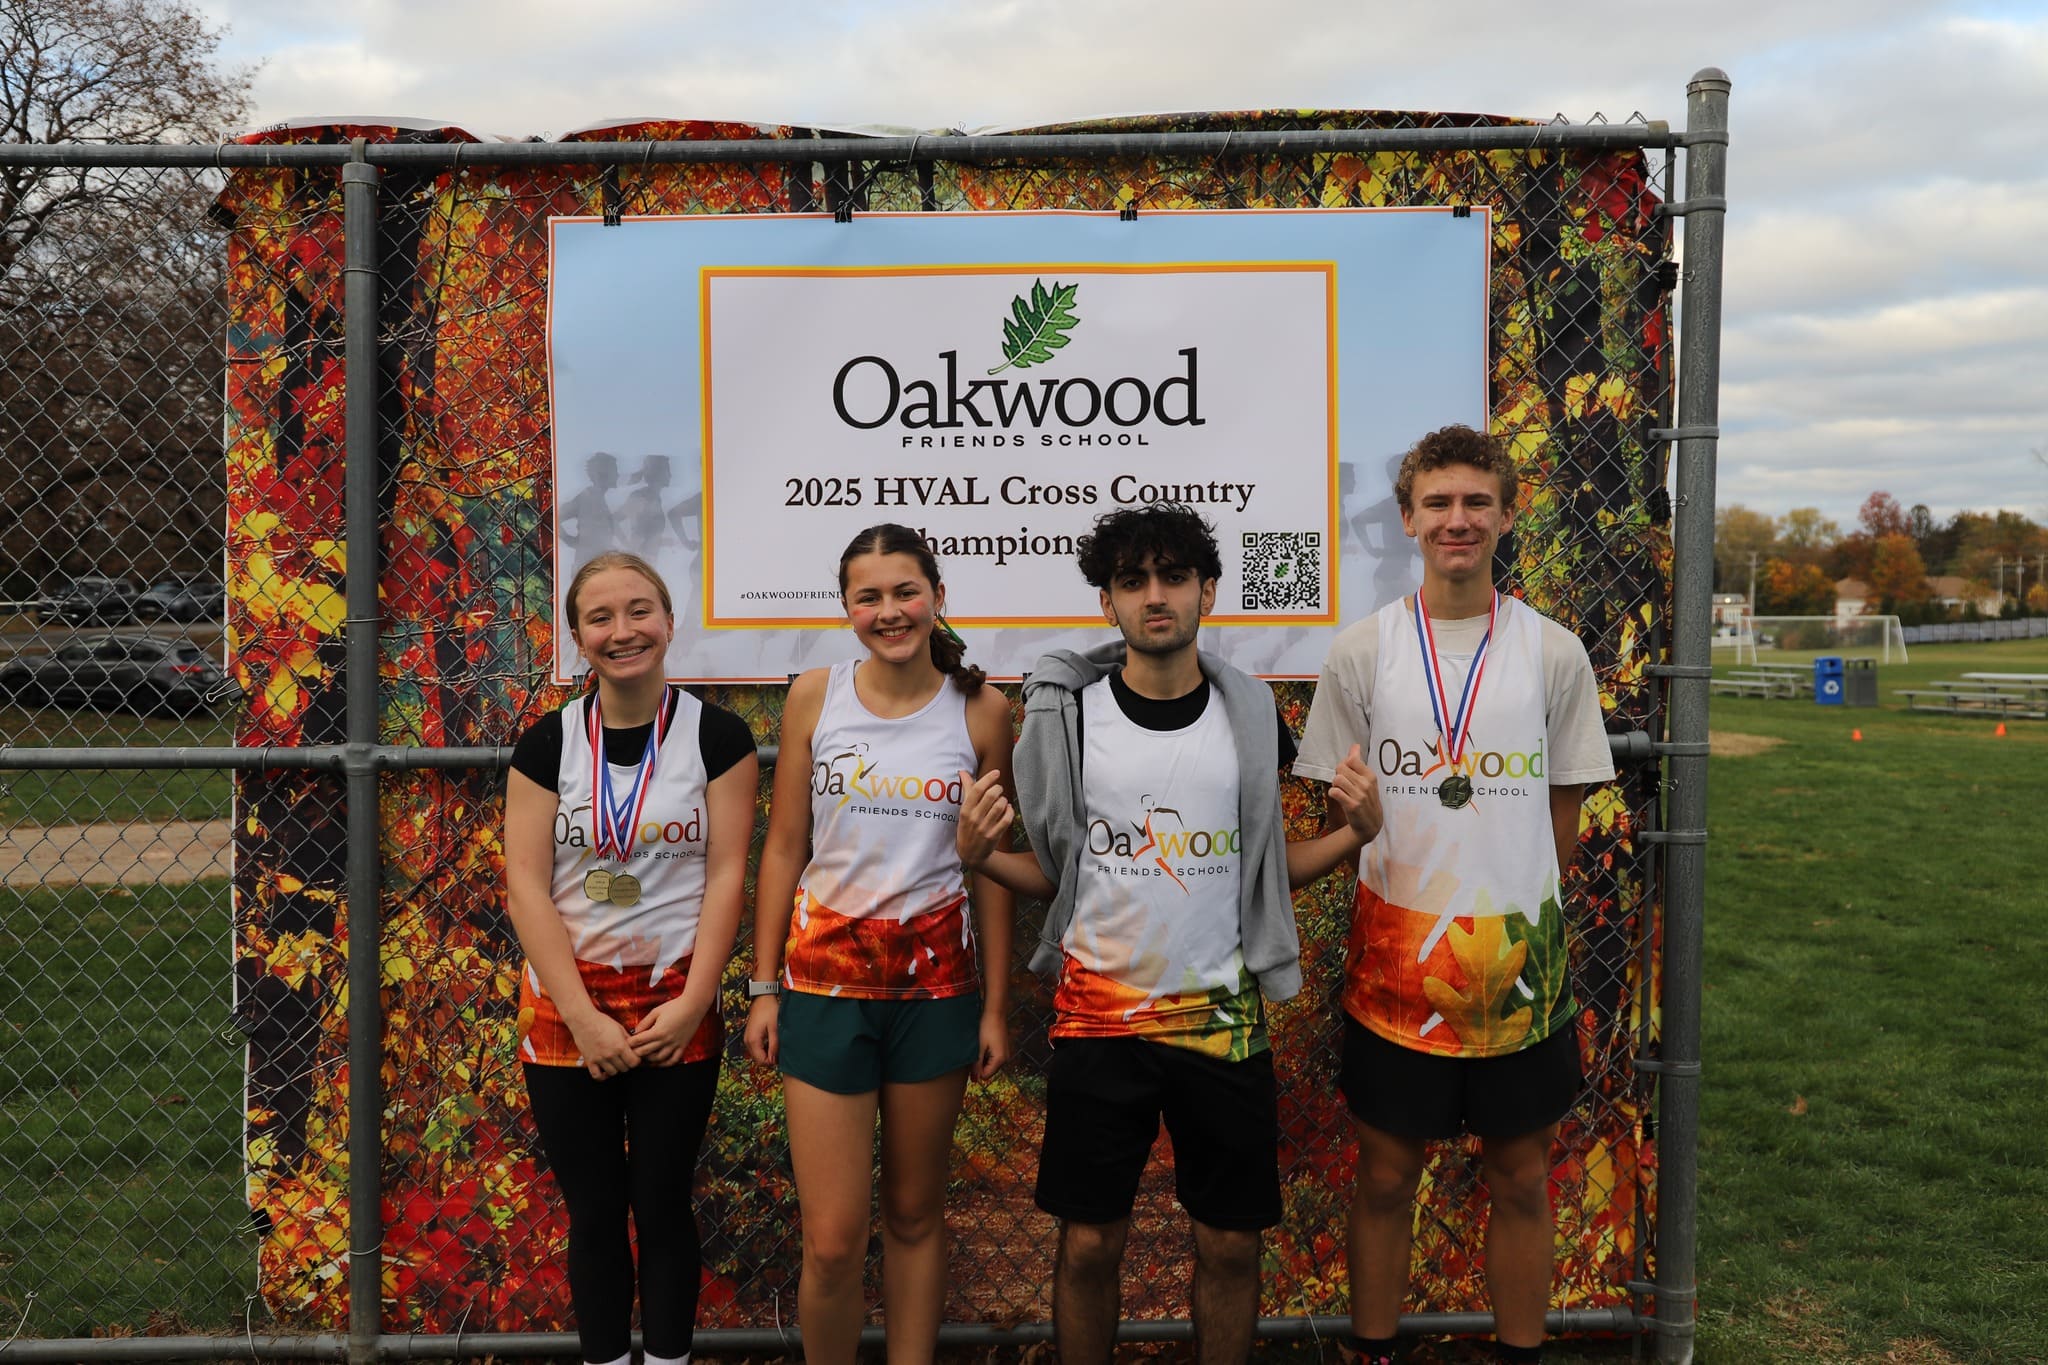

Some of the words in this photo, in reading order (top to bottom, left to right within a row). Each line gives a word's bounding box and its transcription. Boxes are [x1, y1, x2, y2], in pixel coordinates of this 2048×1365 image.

[832, 347, 1206, 430] Oakwood
[902, 434, 1025, 448] FRIENDS
[1041, 433, 1150, 446] SCHOOL
[785, 477, 863, 507] 2025
[874, 476, 990, 507] HVAL
[1000, 475, 1098, 505] Cross
[1110, 474, 1257, 513] Country
[911, 527, 1091, 565] hampions
[1385, 786, 1440, 796] FRIEND
[851, 806, 909, 817] FRIENDS
[1097, 865, 1162, 877] FRIENDS
[1177, 865, 1230, 876] SCHOOL
